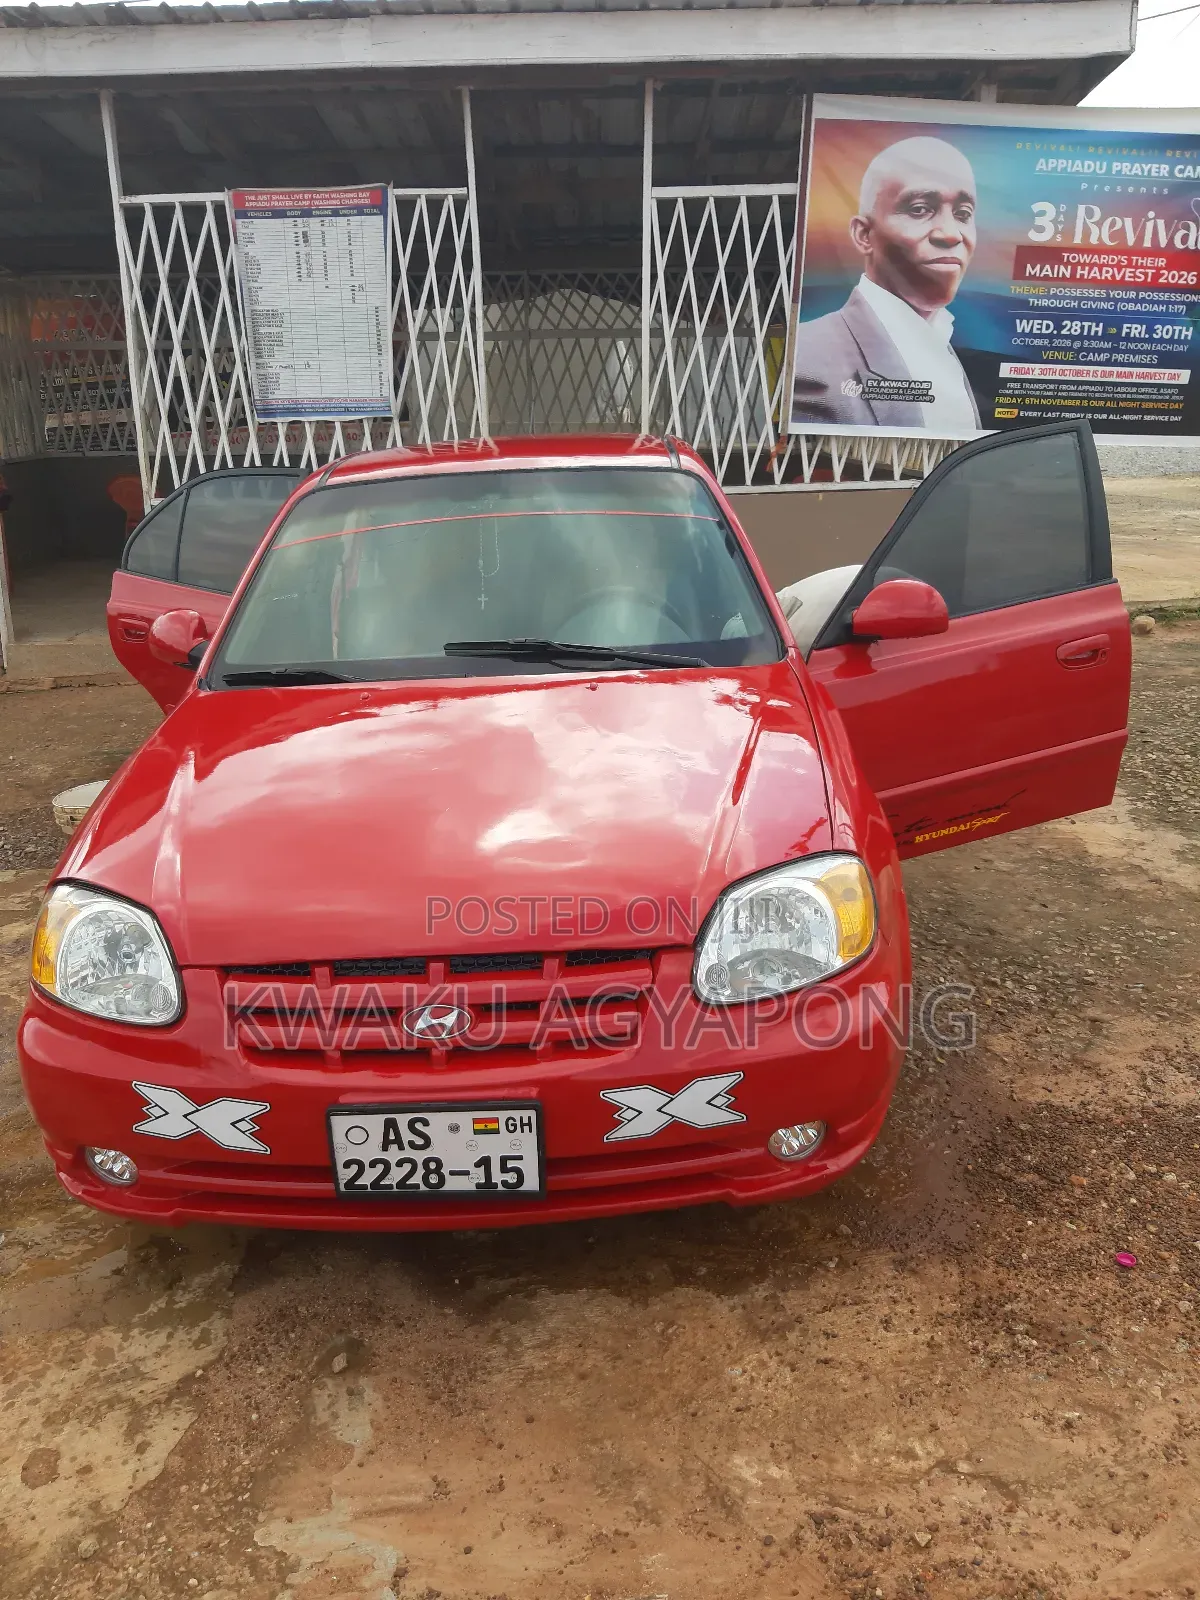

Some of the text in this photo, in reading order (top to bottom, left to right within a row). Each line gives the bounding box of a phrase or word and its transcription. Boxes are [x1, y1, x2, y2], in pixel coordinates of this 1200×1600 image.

[1036, 159, 1107, 173] APPIADU
[1112, 162, 1169, 177] PRAYER
[1081, 183, 1169, 195] Presents
[1028, 202, 1056, 241] 3
[1062, 253, 1167, 267] TOWARD'S THEIR
[1025, 264, 1197, 284] MAIN HARVEST 2026
[1011, 286, 1047, 295] THEME:
[1050, 287, 1106, 297] POSSESSES
[1109, 290, 1135, 299] YOUR
[1029, 299, 1186, 314] THROUGH GIVING (OBADIAH 1:17)
[1016, 319, 1193, 340] WED. 28TH FRI. 30TH
[1012, 338, 1051, 347] OCTOBER,
[1052, 339, 1071, 347] 2026
[1073, 341, 1081, 349] @
[1083, 340, 1111, 349] 9:30AM
[1119, 342, 1126, 350] 12
[1127, 343, 1151, 351] NOON
[1152, 344, 1172, 352] EACH
[1042, 351, 1158, 364] VENUE: CAMP PREMISES
[1038, 367, 1057, 376] 30TH
[1058, 369, 1090, 378] OCTOBER
[1092, 370, 1099, 378] IS
[1100, 370, 1114, 378] OUR
[1115, 371, 1134, 380] MAIN
[1135, 372, 1167, 380] HARVEST
[1167, 373, 1181, 381] DAY
[995, 396, 1023, 405] FRIDAY,
[1040, 398, 1080, 406] NOVEMBER
[914, 822, 970, 843] HYUNDAI
[381, 1115, 533, 1152] AS GH
[342, 1154, 525, 1190] 2228-15
